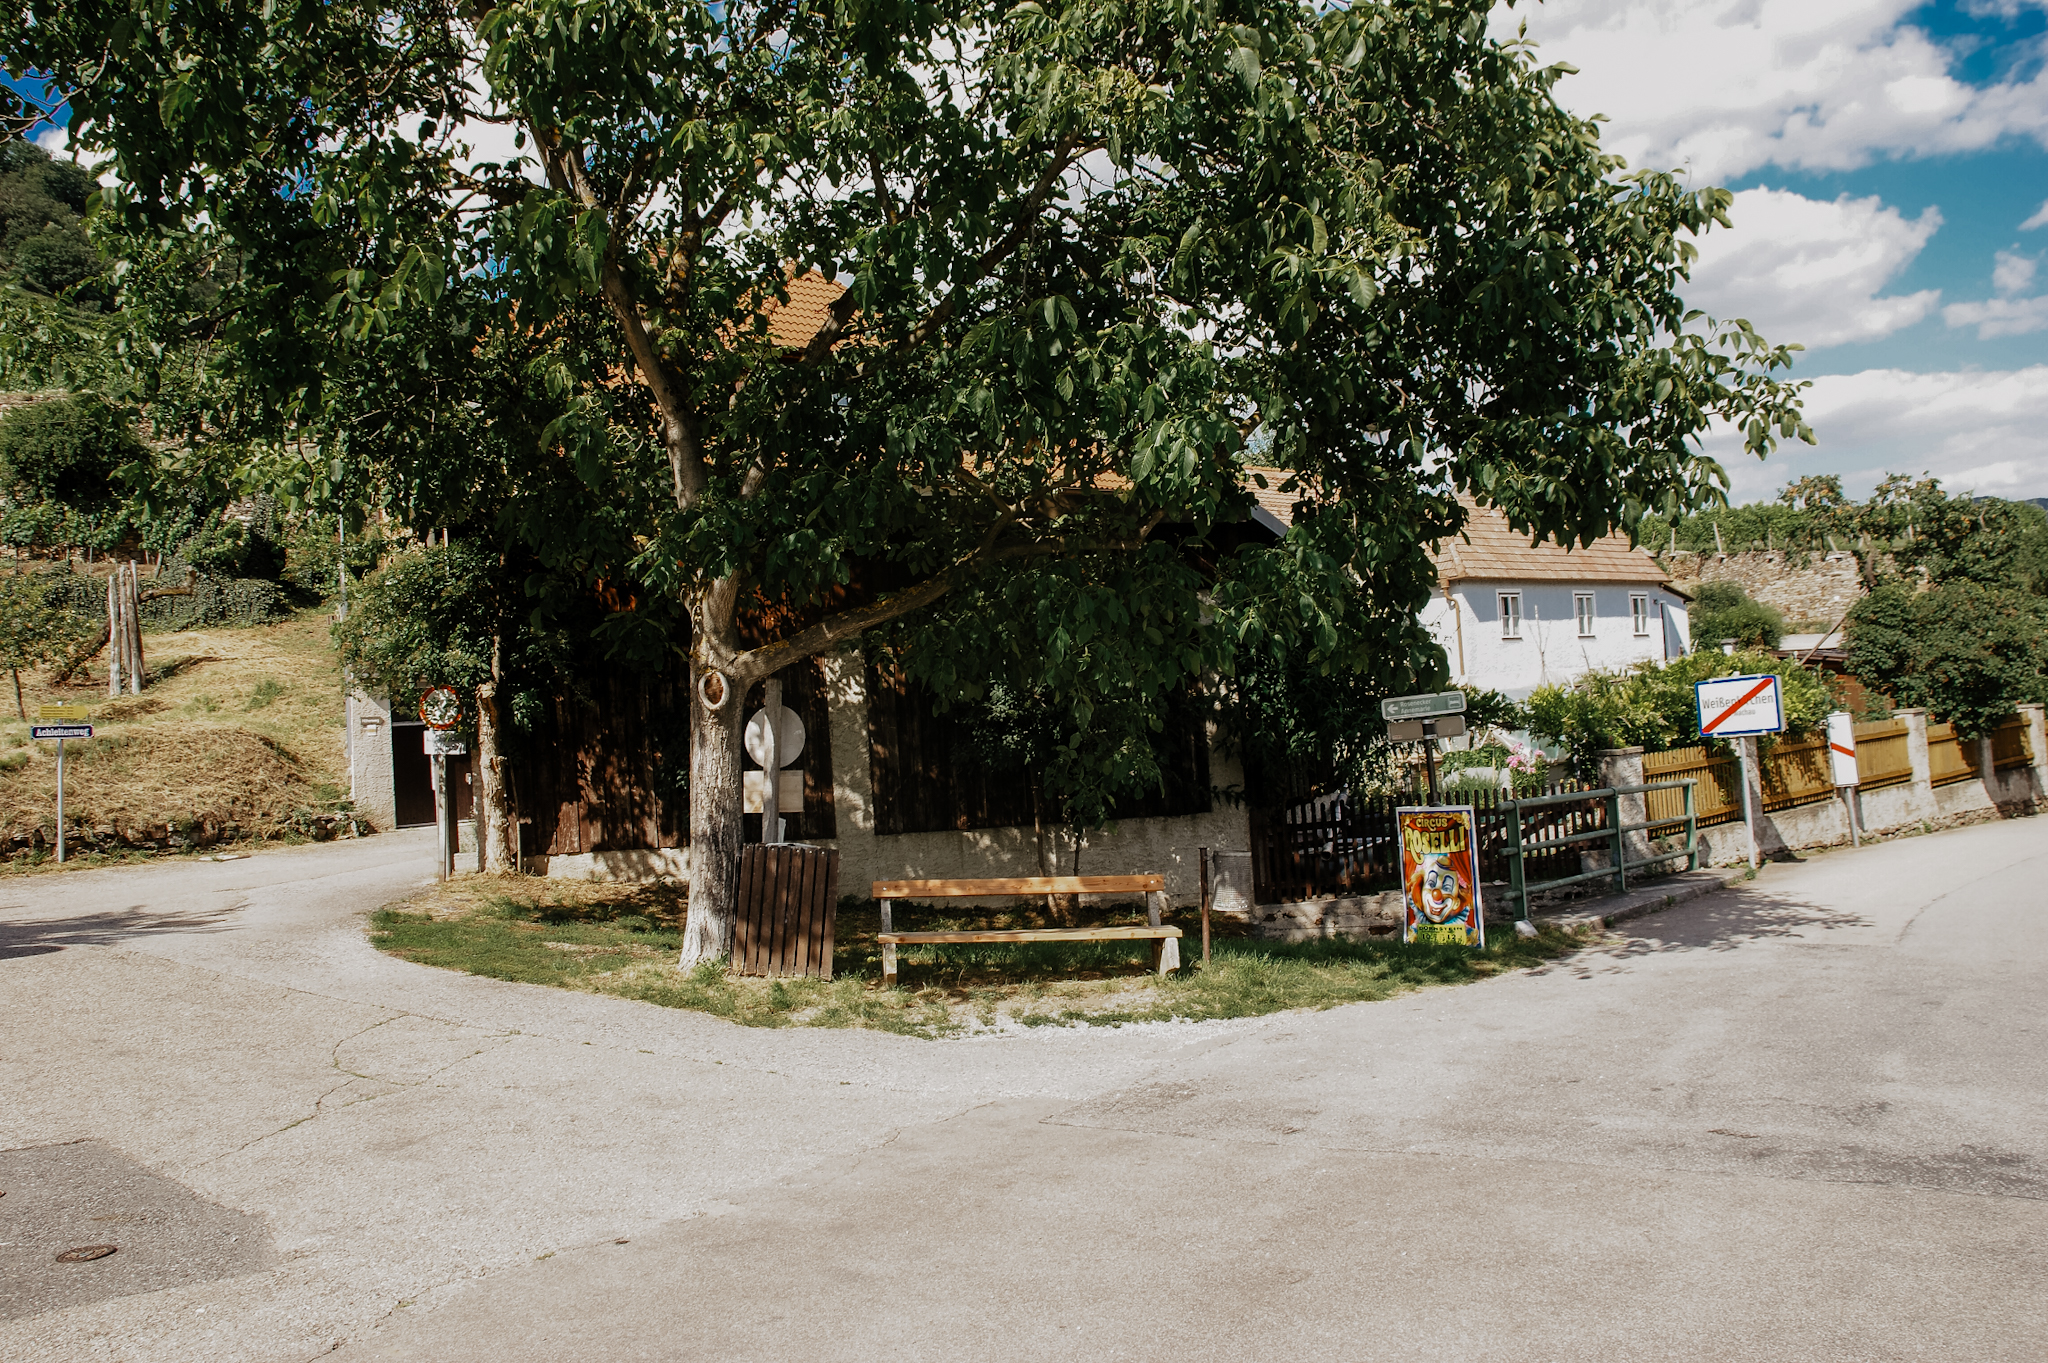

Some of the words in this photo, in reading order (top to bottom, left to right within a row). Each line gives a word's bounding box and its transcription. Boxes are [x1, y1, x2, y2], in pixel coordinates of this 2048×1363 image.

[1399, 698, 1432, 707] Rosenecker
[1702, 694, 1774, 709] Weißenchen
[1400, 705, 1431, 714] Annemarie
[35, 728, 91, 737] Achleitenweg
[1415, 818, 1448, 831] CIRCUS
[1404, 825, 1467, 865] ROSELLI
